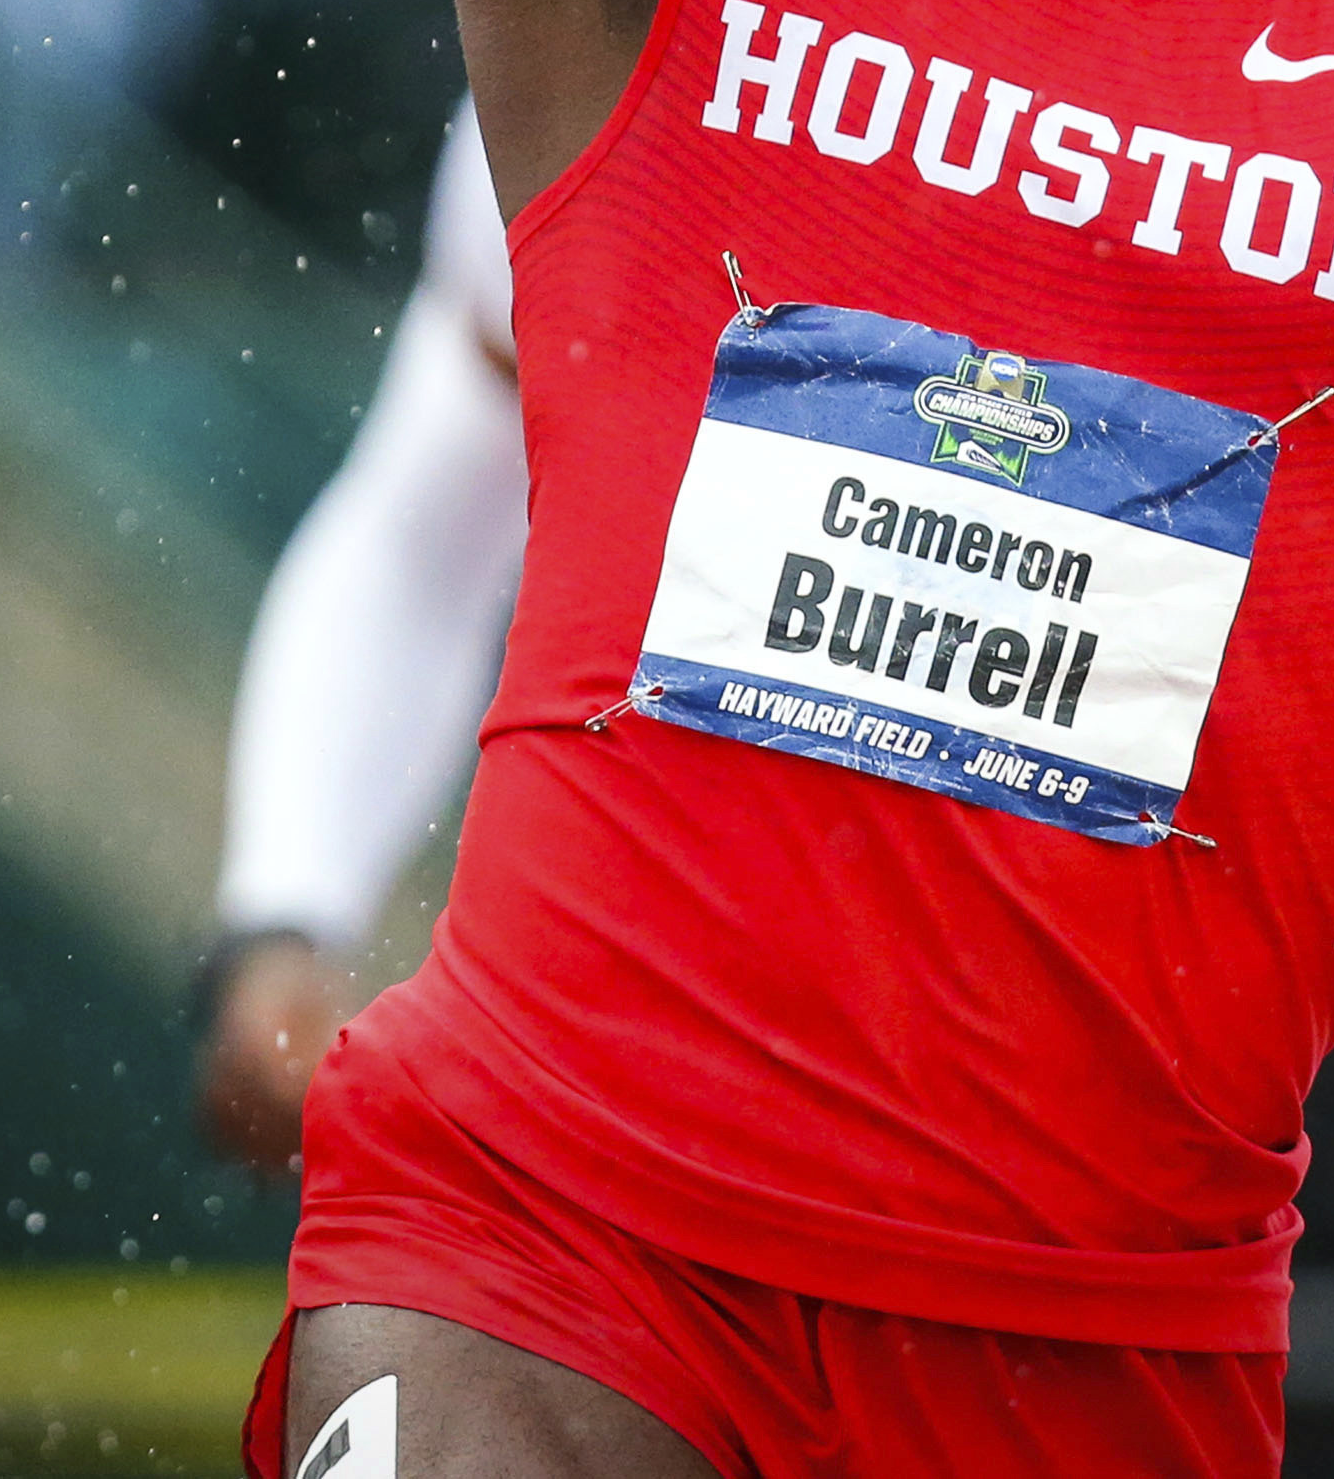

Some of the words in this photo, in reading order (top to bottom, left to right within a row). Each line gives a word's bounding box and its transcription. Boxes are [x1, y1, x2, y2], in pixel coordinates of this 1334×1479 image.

[929, 393, 1055, 441] CHAMPIONSHIPS
[822, 476, 1092, 603] Cameron
[764, 552, 1098, 728] Burrell
[718, 681, 854, 738] HAYWARD
[853, 714, 933, 759] FIELD
[963, 748, 1039, 791] JUNE
[1037, 768, 1089, 805] 6-9
